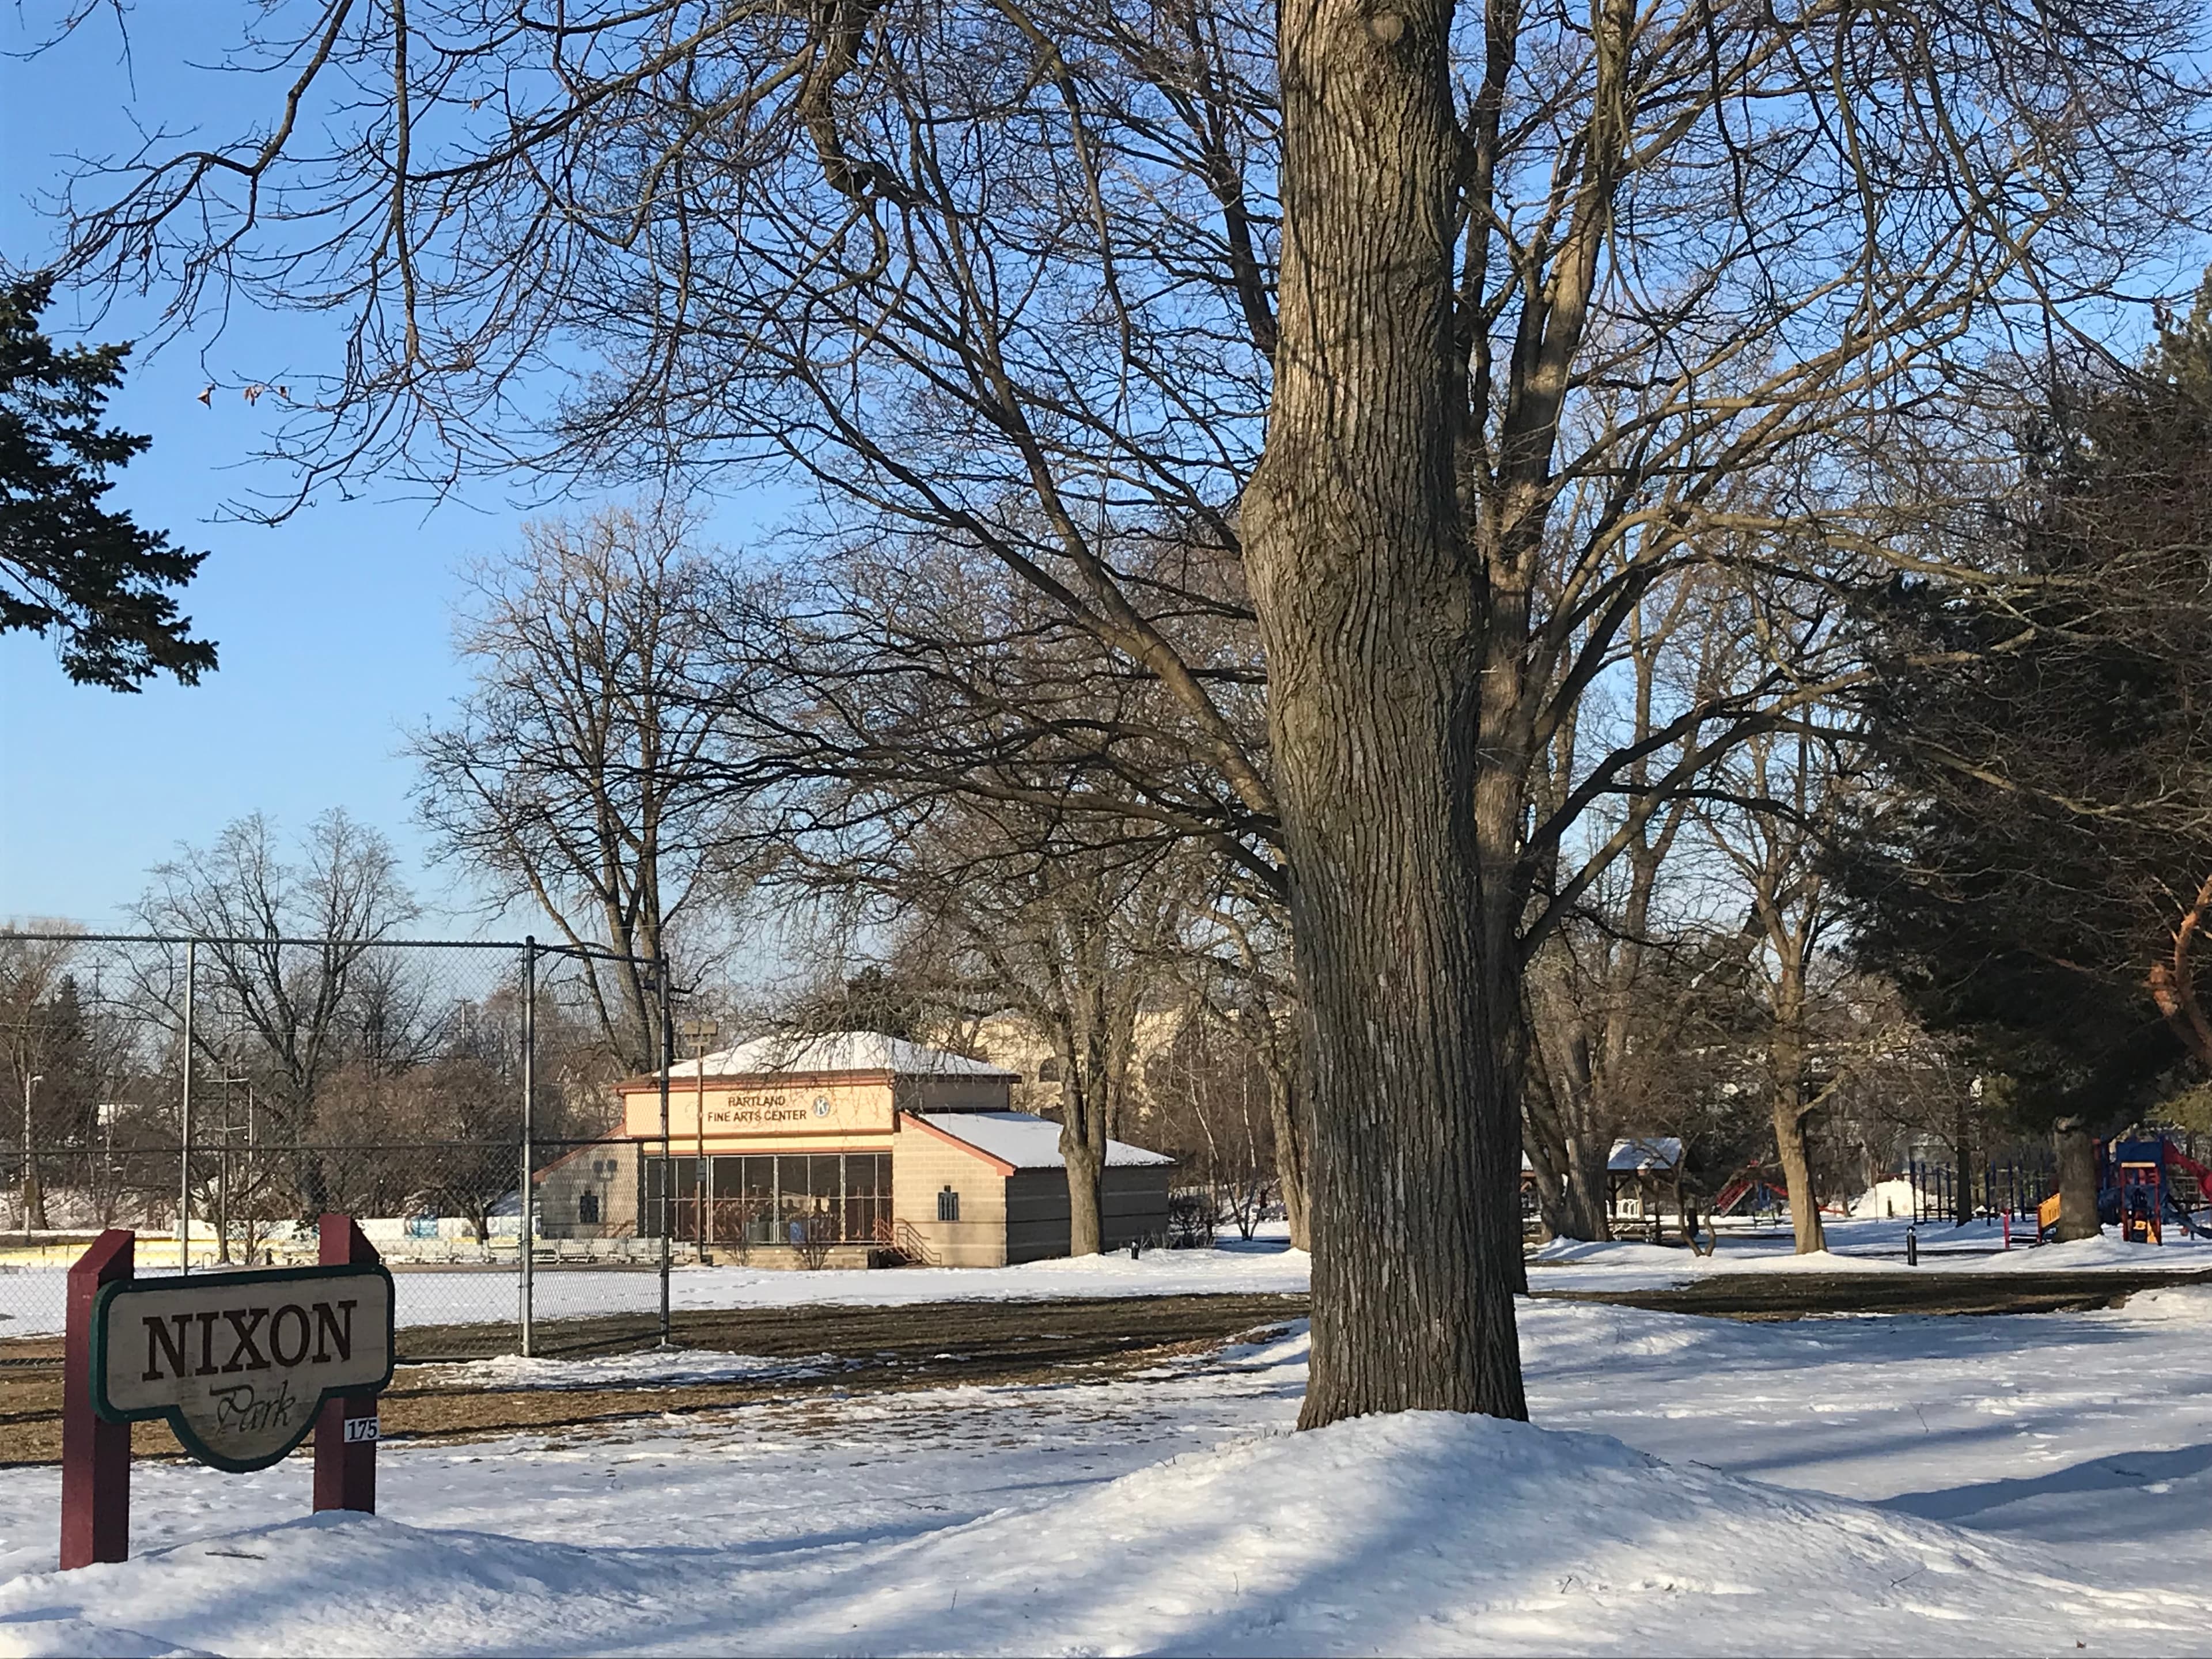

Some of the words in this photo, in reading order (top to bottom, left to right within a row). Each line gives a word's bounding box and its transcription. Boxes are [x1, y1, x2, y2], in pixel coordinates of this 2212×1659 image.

[728, 1096, 786, 1107] HARTLAND
[708, 1111, 730, 1122] FINE
[733, 1111, 762, 1122] ARTS
[764, 1109, 806, 1121] CENTER
[142, 1300, 357, 1382] NIXON
[209, 1379, 296, 1435] Park
[348, 1421, 378, 1441] 175
